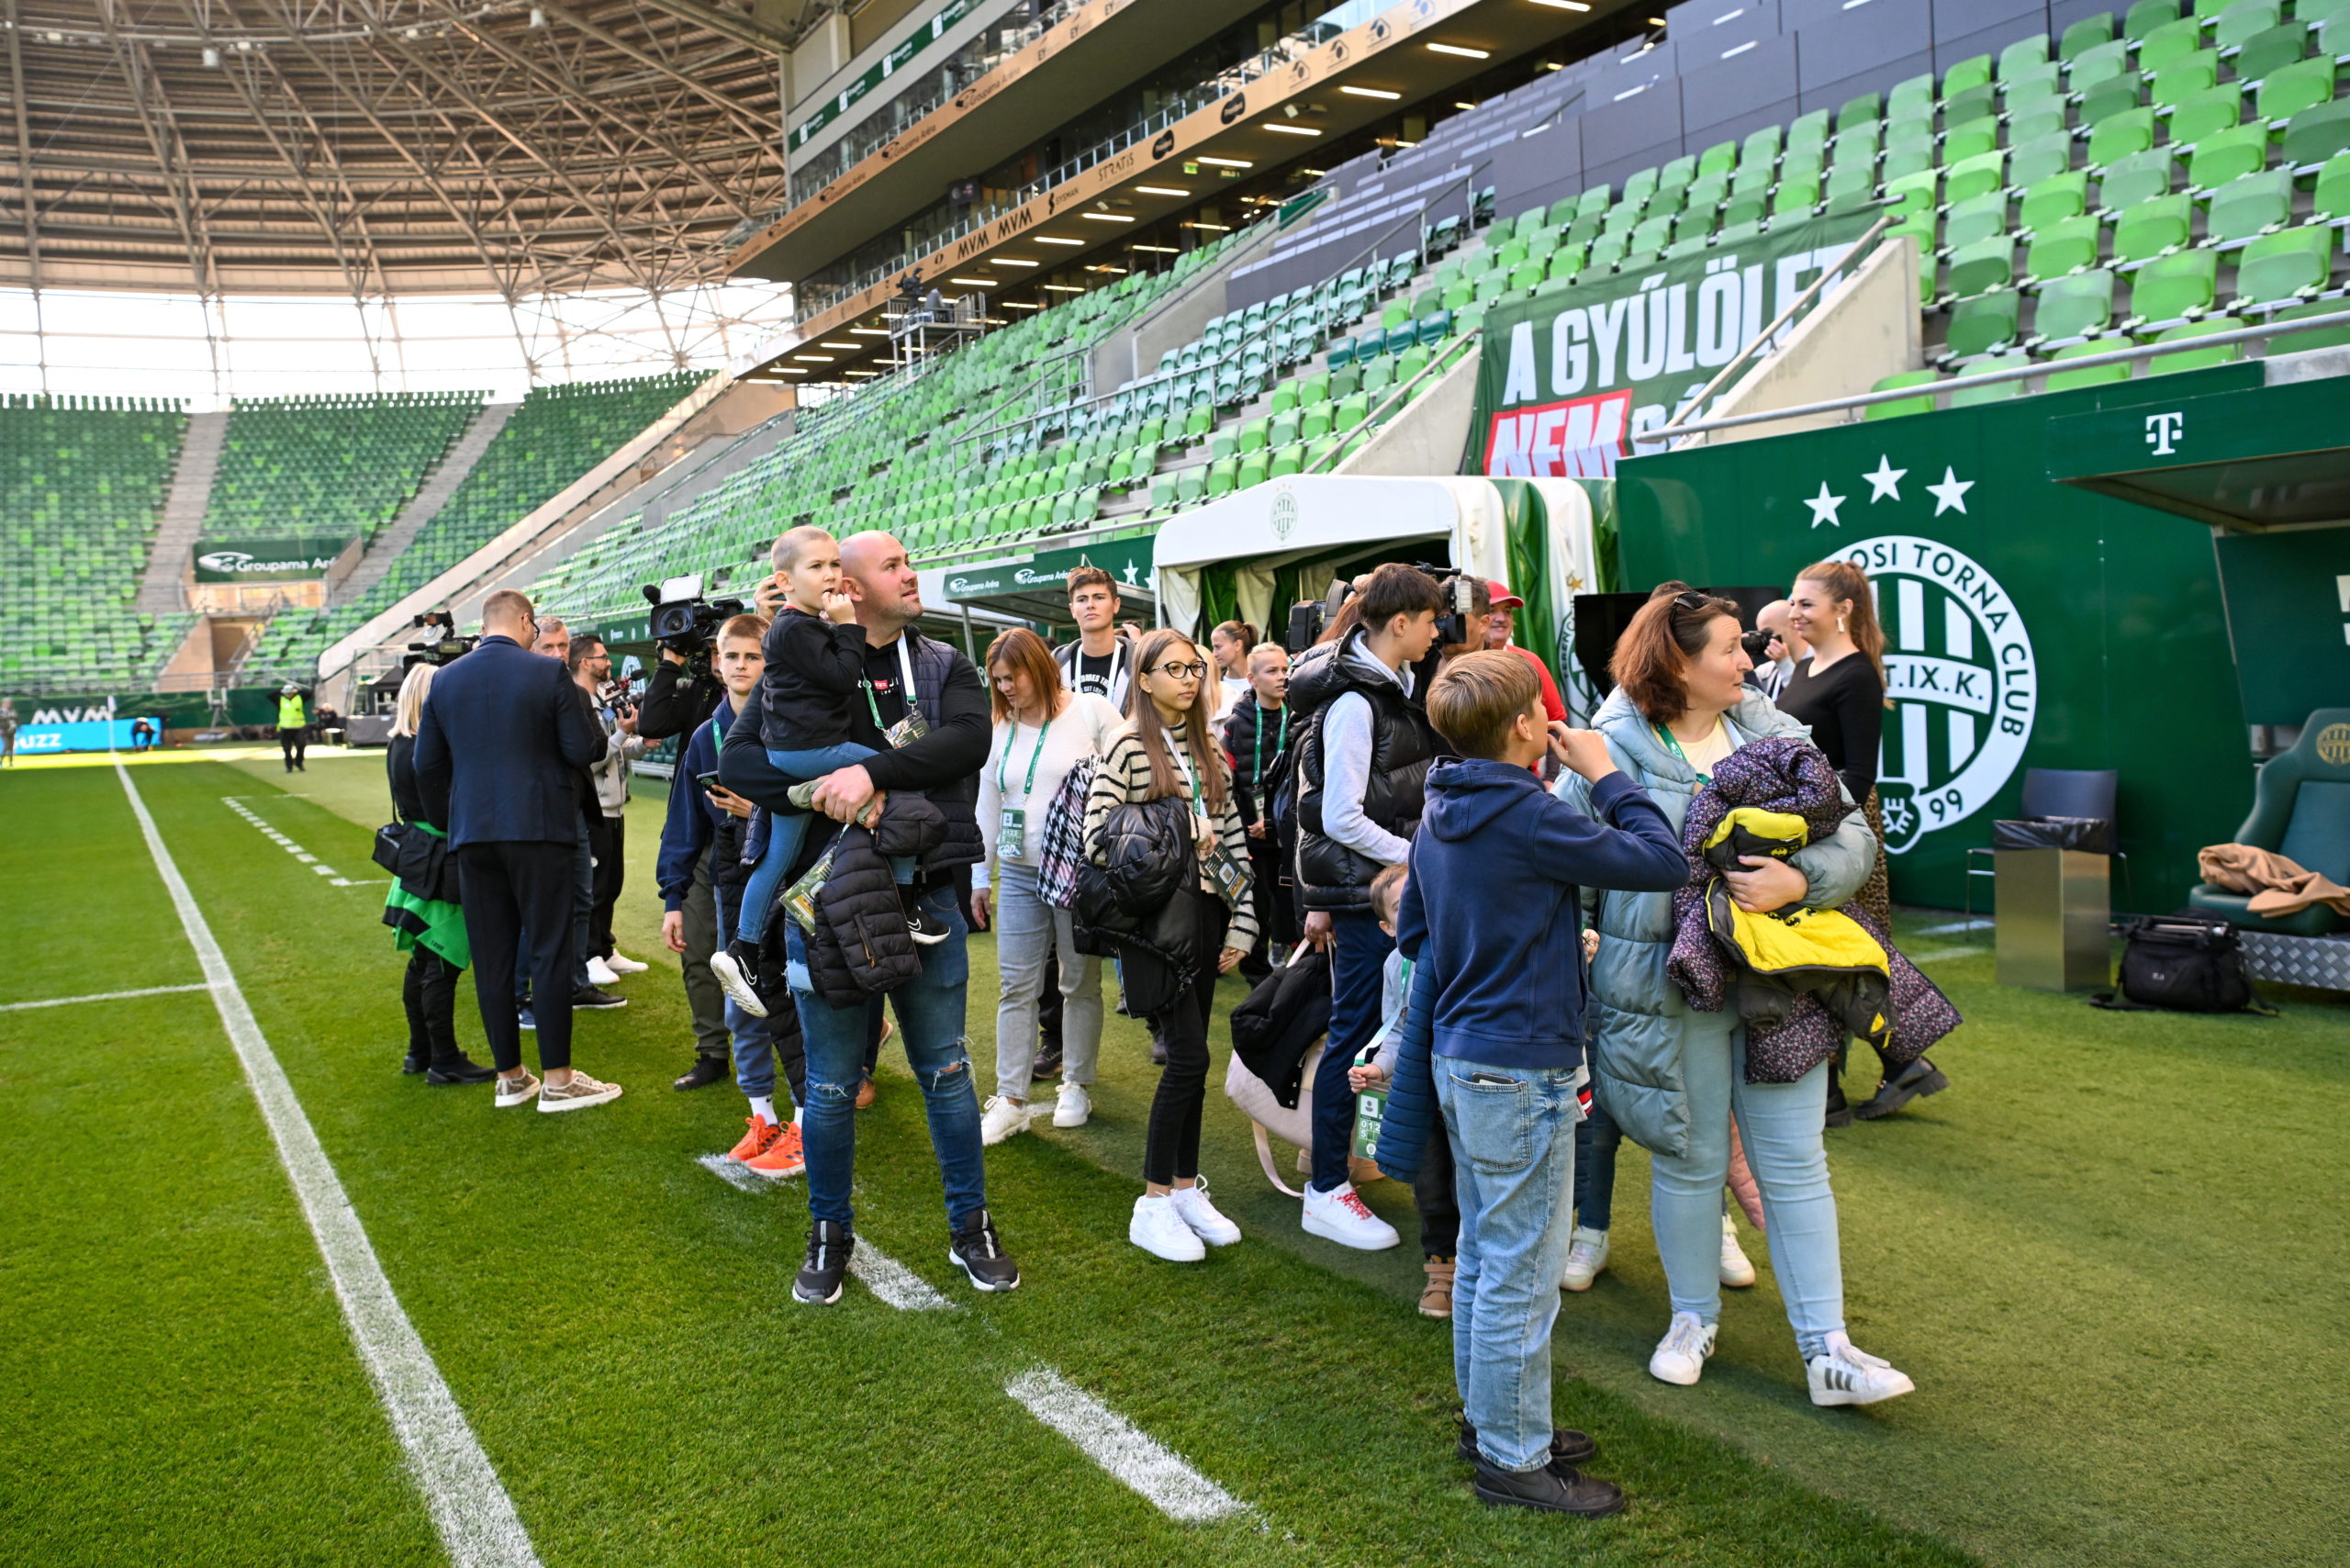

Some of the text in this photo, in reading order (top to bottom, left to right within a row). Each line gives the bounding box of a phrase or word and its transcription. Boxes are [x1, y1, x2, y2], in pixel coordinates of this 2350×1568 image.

[1069, 26, 1080, 39] EY
[1037, 48, 1046, 62] EY
[997, 207, 1033, 240] MVM
[957, 230, 990, 262] MVM
[1502, 320, 1538, 406] A
[2145, 411, 2183, 456] T
[236, 558, 308, 573] Groupama
[960, 583, 985, 593] Groupama
[1027, 574, 1055, 585] Groupama
[1913, 543, 2009, 633] TORNA
[2001, 643, 2031, 736] CLUB
[30, 706, 111, 725] MVM
